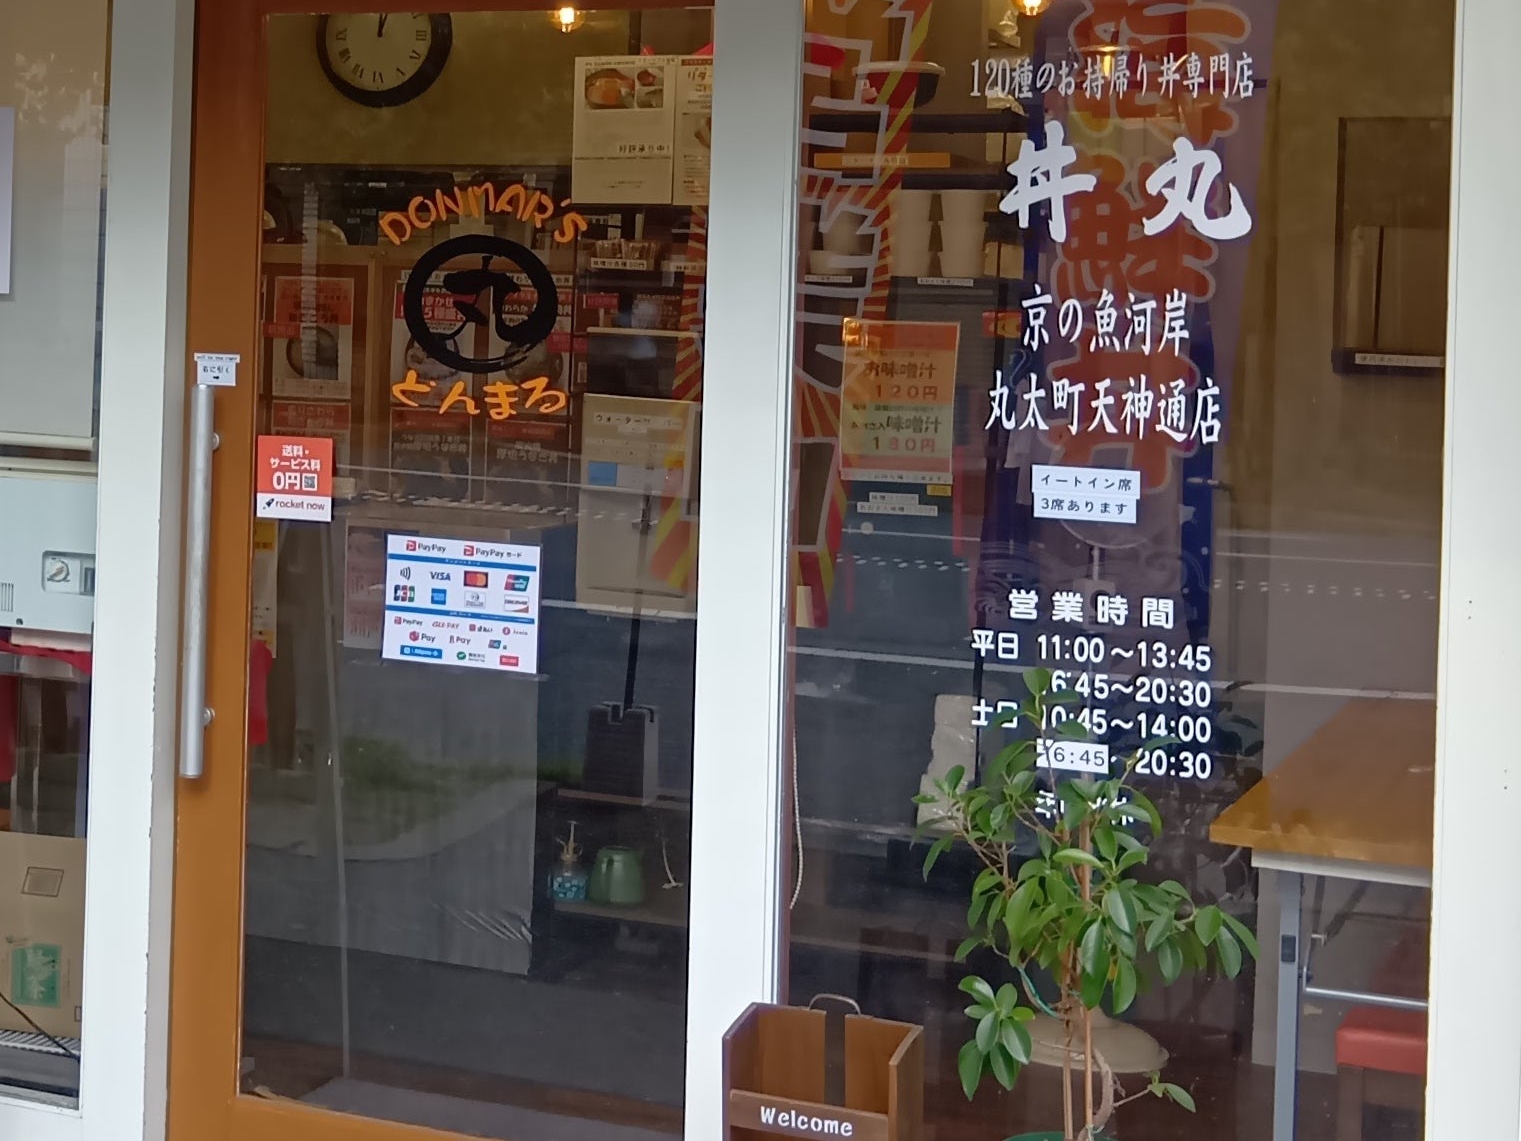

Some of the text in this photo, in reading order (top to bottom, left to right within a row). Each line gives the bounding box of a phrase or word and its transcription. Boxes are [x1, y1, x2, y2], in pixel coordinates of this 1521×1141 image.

[969, 52, 1255, 100] 120種のお持帰り丼専門店
[998, 120, 1252, 243] 丼丸
[1022, 284, 1190, 356] 京の魚河岸
[392, 369, 567, 420] どんまる
[875, 384, 938, 399] 120円
[984, 369, 1222, 445] 丸太町天神通店
[269, 457, 321, 472] サービス料
[272, 471, 301, 491] 0円
[1040, 473, 1132, 491] イートイン席
[275, 499, 325, 511] rocket now
[1040, 497, 1129, 515] 3席あります
[418, 543, 446, 553] PayPay
[476, 547, 504, 558] PayPay
[430, 571, 451, 582] VISA
[1008, 588, 1174, 629] 営業時間
[971, 629, 1020, 660] 平日
[760, 1105, 853, 1137] Welcome
